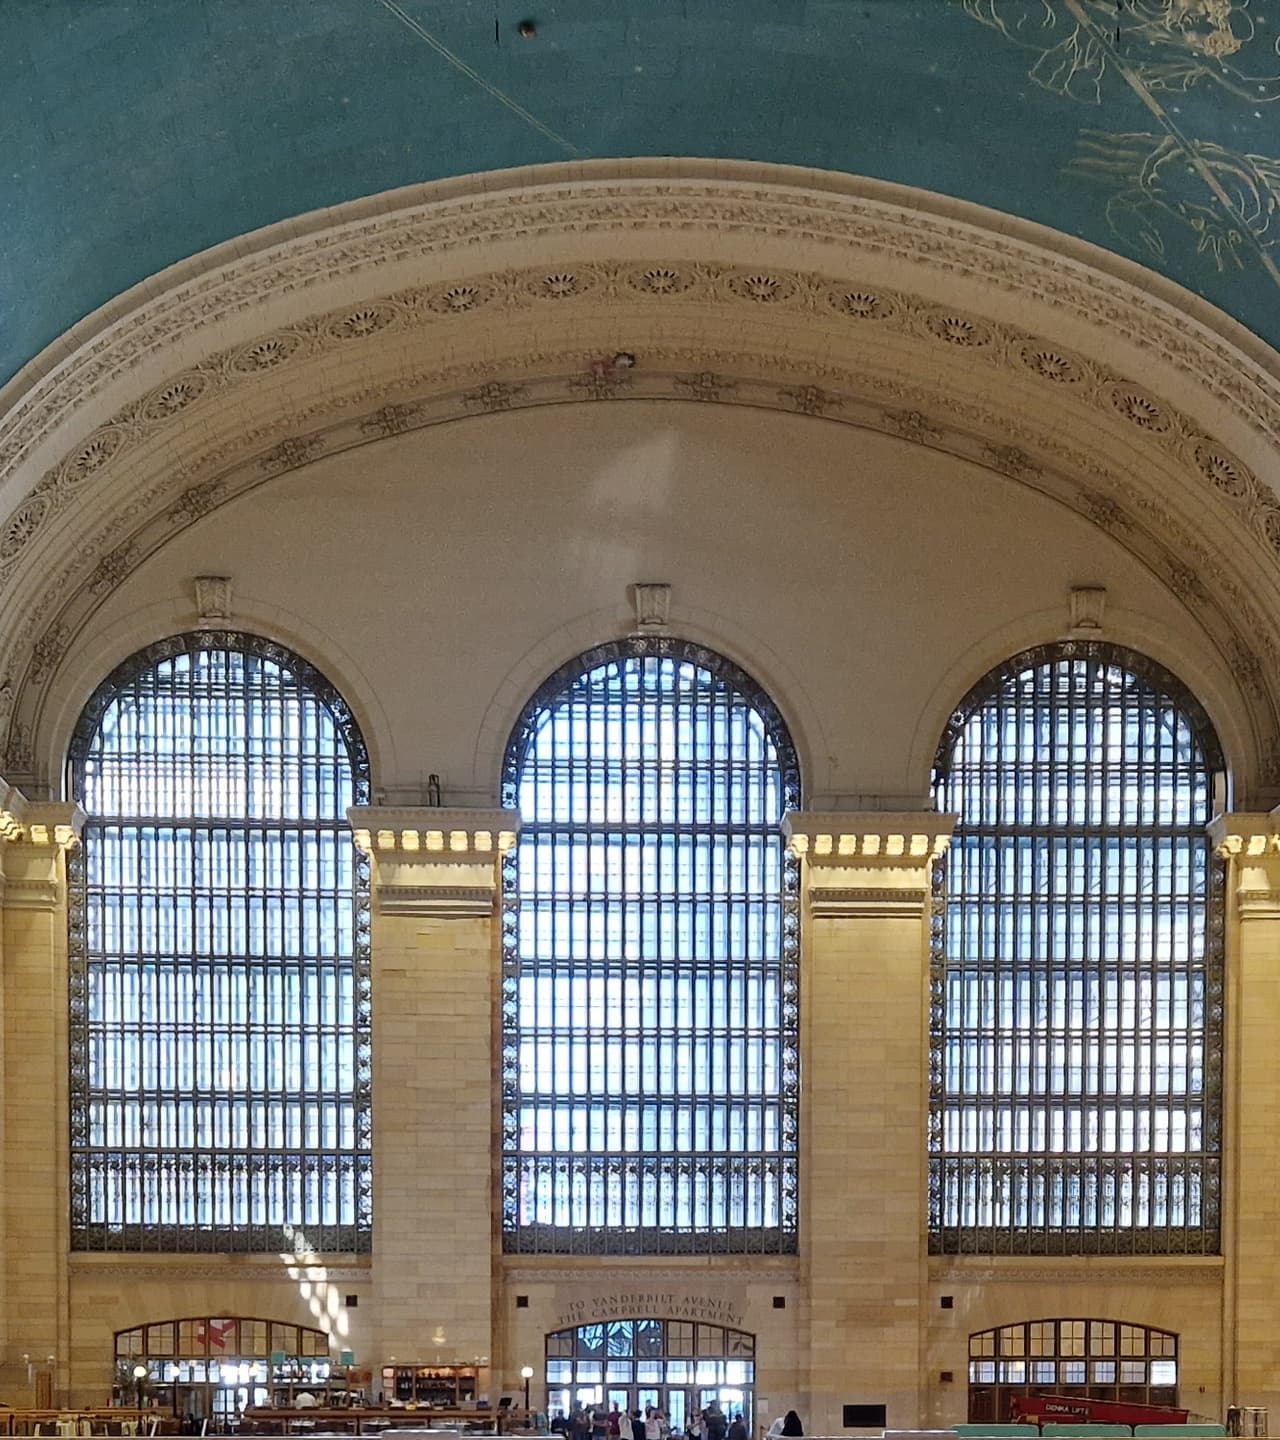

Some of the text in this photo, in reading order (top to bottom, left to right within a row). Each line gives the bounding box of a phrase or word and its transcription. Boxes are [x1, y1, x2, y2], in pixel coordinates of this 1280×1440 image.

[568, 1294, 735, 1311] TO VANDERBILT AVENUE
[558, 1304, 745, 1326] THE CAMPBELL APARTMENT
